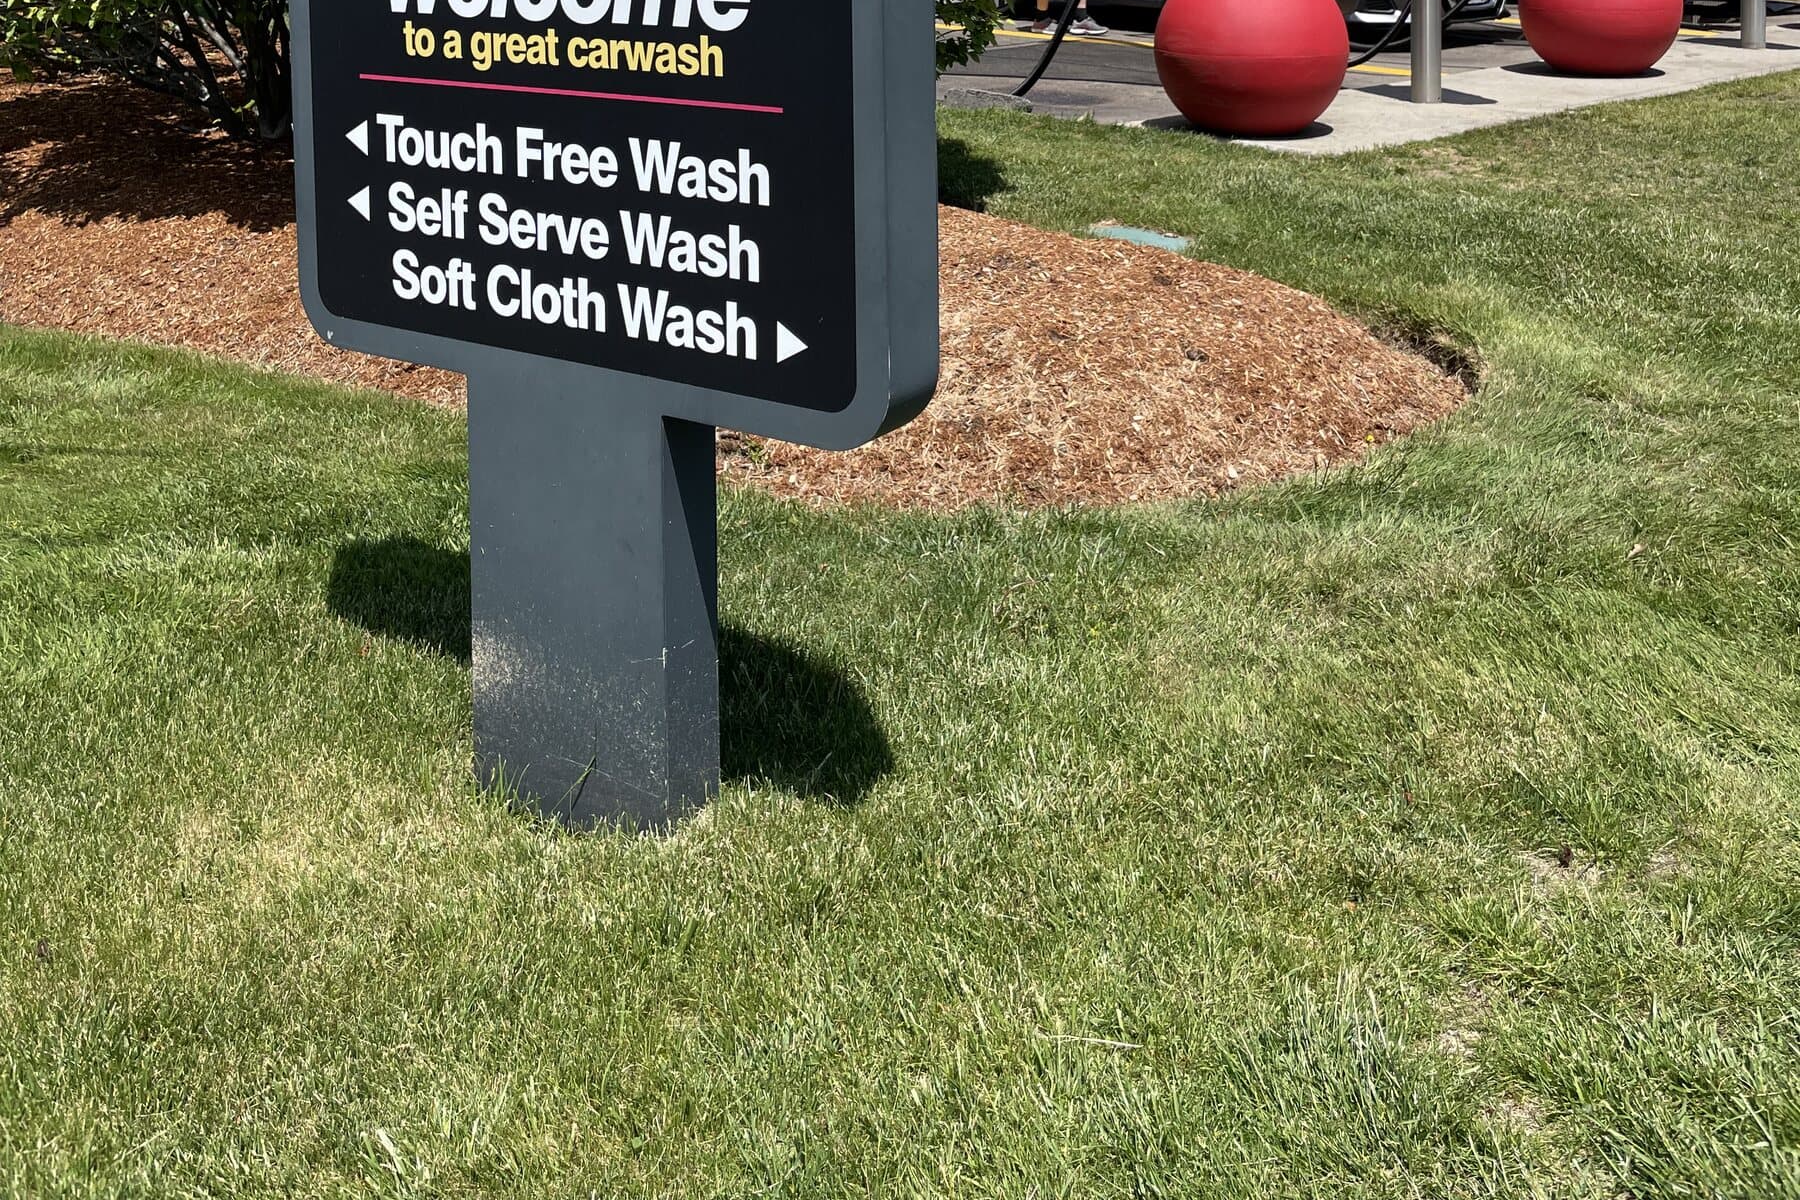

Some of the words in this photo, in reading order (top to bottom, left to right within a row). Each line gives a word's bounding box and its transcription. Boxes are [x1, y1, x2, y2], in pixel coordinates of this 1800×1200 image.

[403, 21, 435, 57] to
[444, 30, 462, 59] a
[471, 29, 560, 70] great
[567, 35, 724, 77] carwash
[376, 113, 504, 175] Touch
[517, 127, 618, 188] Free
[628, 137, 770, 206] Wash
[388, 182, 469, 239] Self
[479, 193, 610, 260] Serve
[619, 210, 760, 282] Wash
[393, 249, 476, 311] Soft
[487, 264, 606, 333] Cloth
[617, 283, 757, 360] Wash
